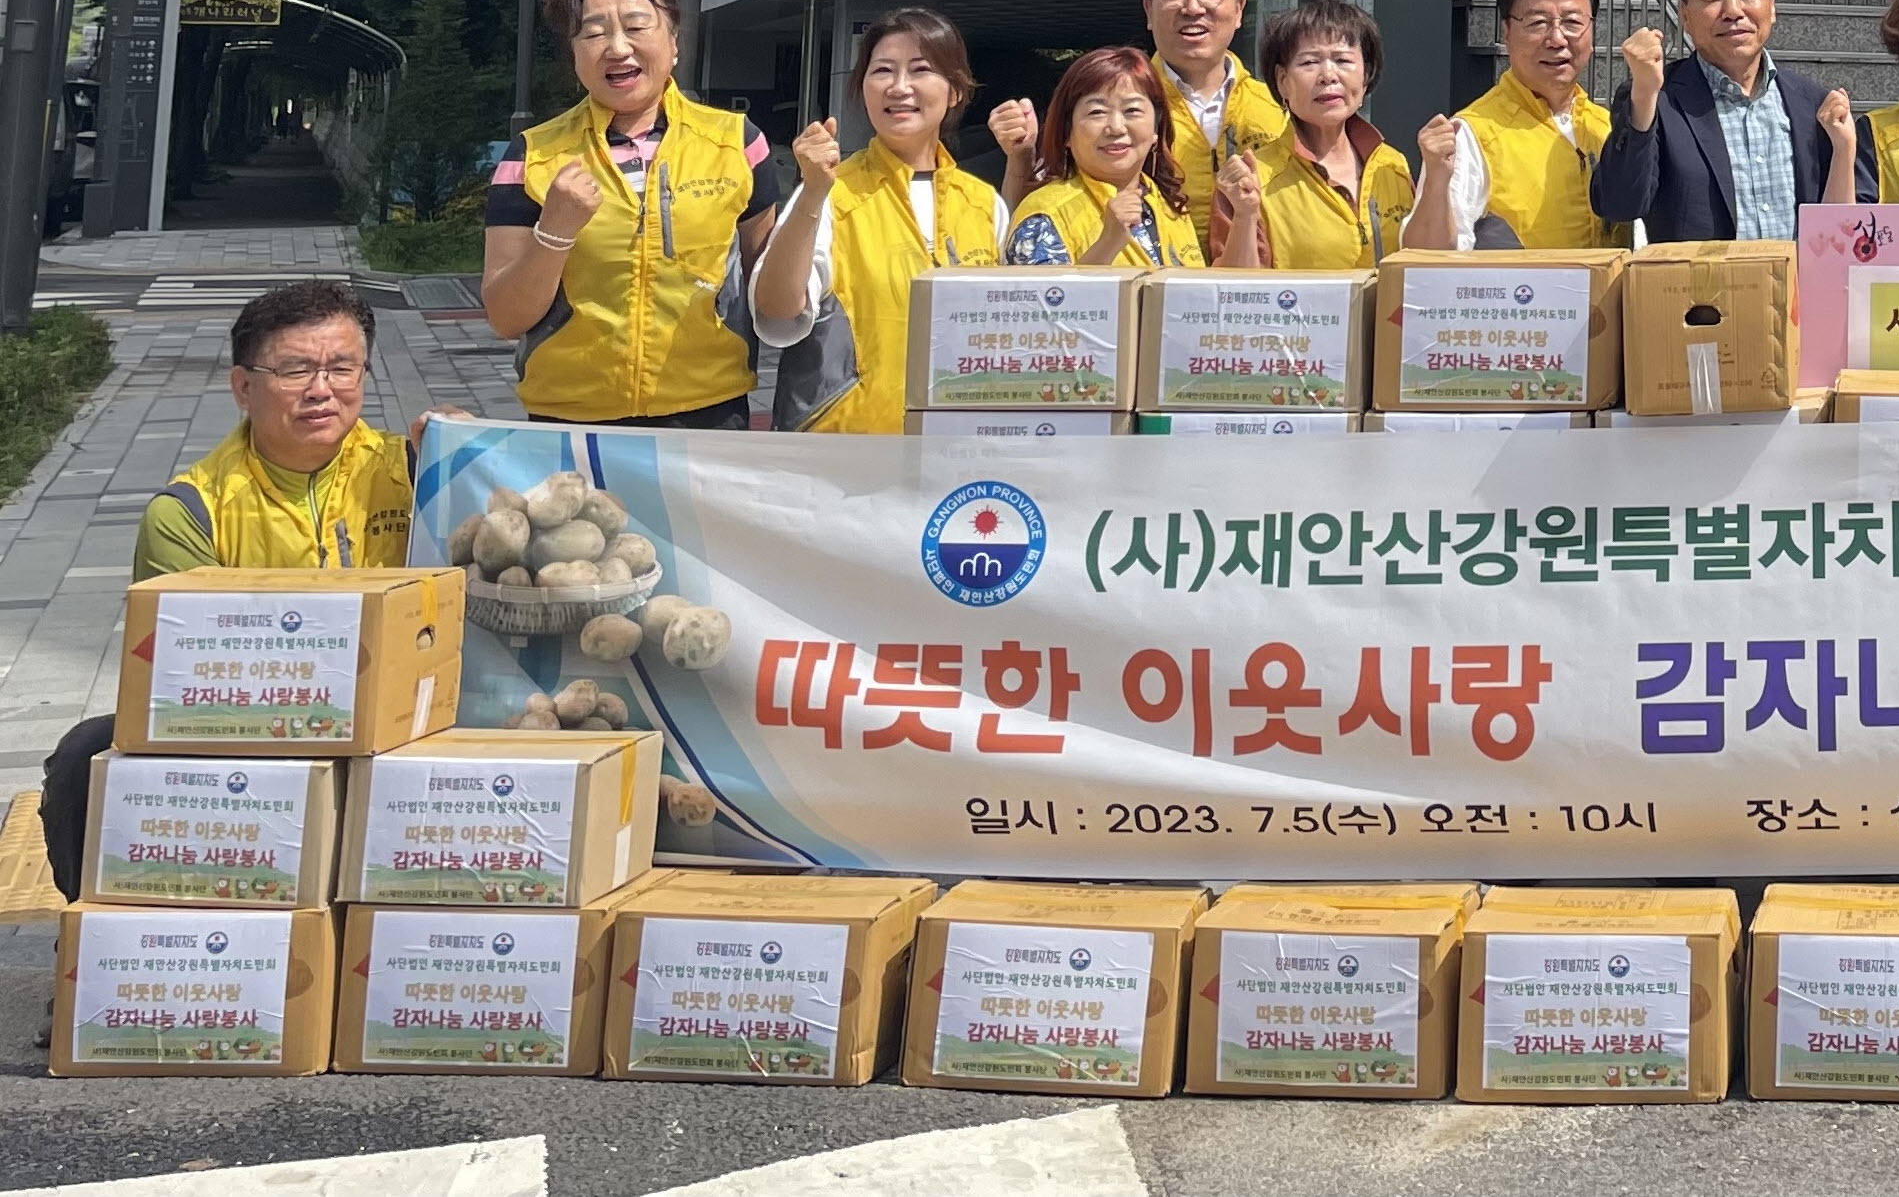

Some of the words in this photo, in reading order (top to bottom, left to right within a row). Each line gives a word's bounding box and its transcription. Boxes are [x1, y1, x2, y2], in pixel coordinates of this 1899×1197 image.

[1436, 329, 1483, 347] 따뜻한
[1487, 329, 1549, 348] 이웃사랑
[956, 355, 1023, 374] 감자나눔
[1027, 354, 1095, 374] 사랑봉사
[1425, 352, 1492, 371] 감자나눔
[1496, 352, 1564, 372] 사랑봉사
[927, 485, 987, 538] GANGWON
[992, 485, 1042, 540] PROVINCE
[925, 548, 956, 594] 사단법인
[192, 661, 245, 680] 따뜻한
[248, 660, 317, 680] 이웃사랑
[179, 686, 253, 706] 감자나눔
[257, 685, 332, 707] 사랑봉사
[755, 639, 1081, 754] 따뜻한
[1120, 640, 1553, 762] 이웃사랑
[965, 797, 1058, 835] 일시
[1105, 803, 1233, 834] 2023.
[1420, 801, 1510, 835] 오전
[1560, 801, 1658, 834] 10시
[1746, 798, 1840, 832] 장소
[139, 817, 191, 839] 따뜻한
[194, 819, 262, 842] 이웃사랑
[126, 842, 199, 866] 감자나눔
[202, 845, 276, 870] 사랑봉사
[391, 850, 465, 871] 감자나눔
[469, 850, 544, 872] 사랑봉사
[116, 982, 169, 1002] 따뜻한
[172, 982, 243, 1002] 이웃사랑
[404, 981, 456, 1002] 따뜻한
[459, 982, 529, 1004] 이웃사랑
[670, 989, 723, 1011] 따뜻한
[726, 991, 796, 1014] 이웃사랑
[103, 1007, 178, 1029] 감자나눔
[182, 1008, 259, 1030] 사랑봉사
[391, 1007, 465, 1030] 감자나눔
[468, 1009, 544, 1032] 사랑봉사
[979, 996, 1032, 1018] 따뜻한
[1035, 998, 1105, 1021] 이웃사랑
[1256, 1004, 1305, 1024] 따뜻한
[1310, 1004, 1376, 1025] 이웃사랑
[1524, 1007, 1575, 1027] 따뜻한
[1580, 1007, 1648, 1027] 이웃사랑
[657, 1015, 731, 1039] 감자나눔
[735, 1018, 811, 1043] 사랑봉사
[965, 1021, 1040, 1045] 감자나눔
[1044, 1024, 1120, 1049] 사랑봉사
[1245, 1029, 1316, 1051] 감자나눔
[1321, 1030, 1393, 1053] 사랑봉사
[1513, 1034, 1586, 1055] 감자나눔
[1591, 1033, 1664, 1055] 사랑봉사
[1807, 1031, 1880, 1055] 감자나눔
